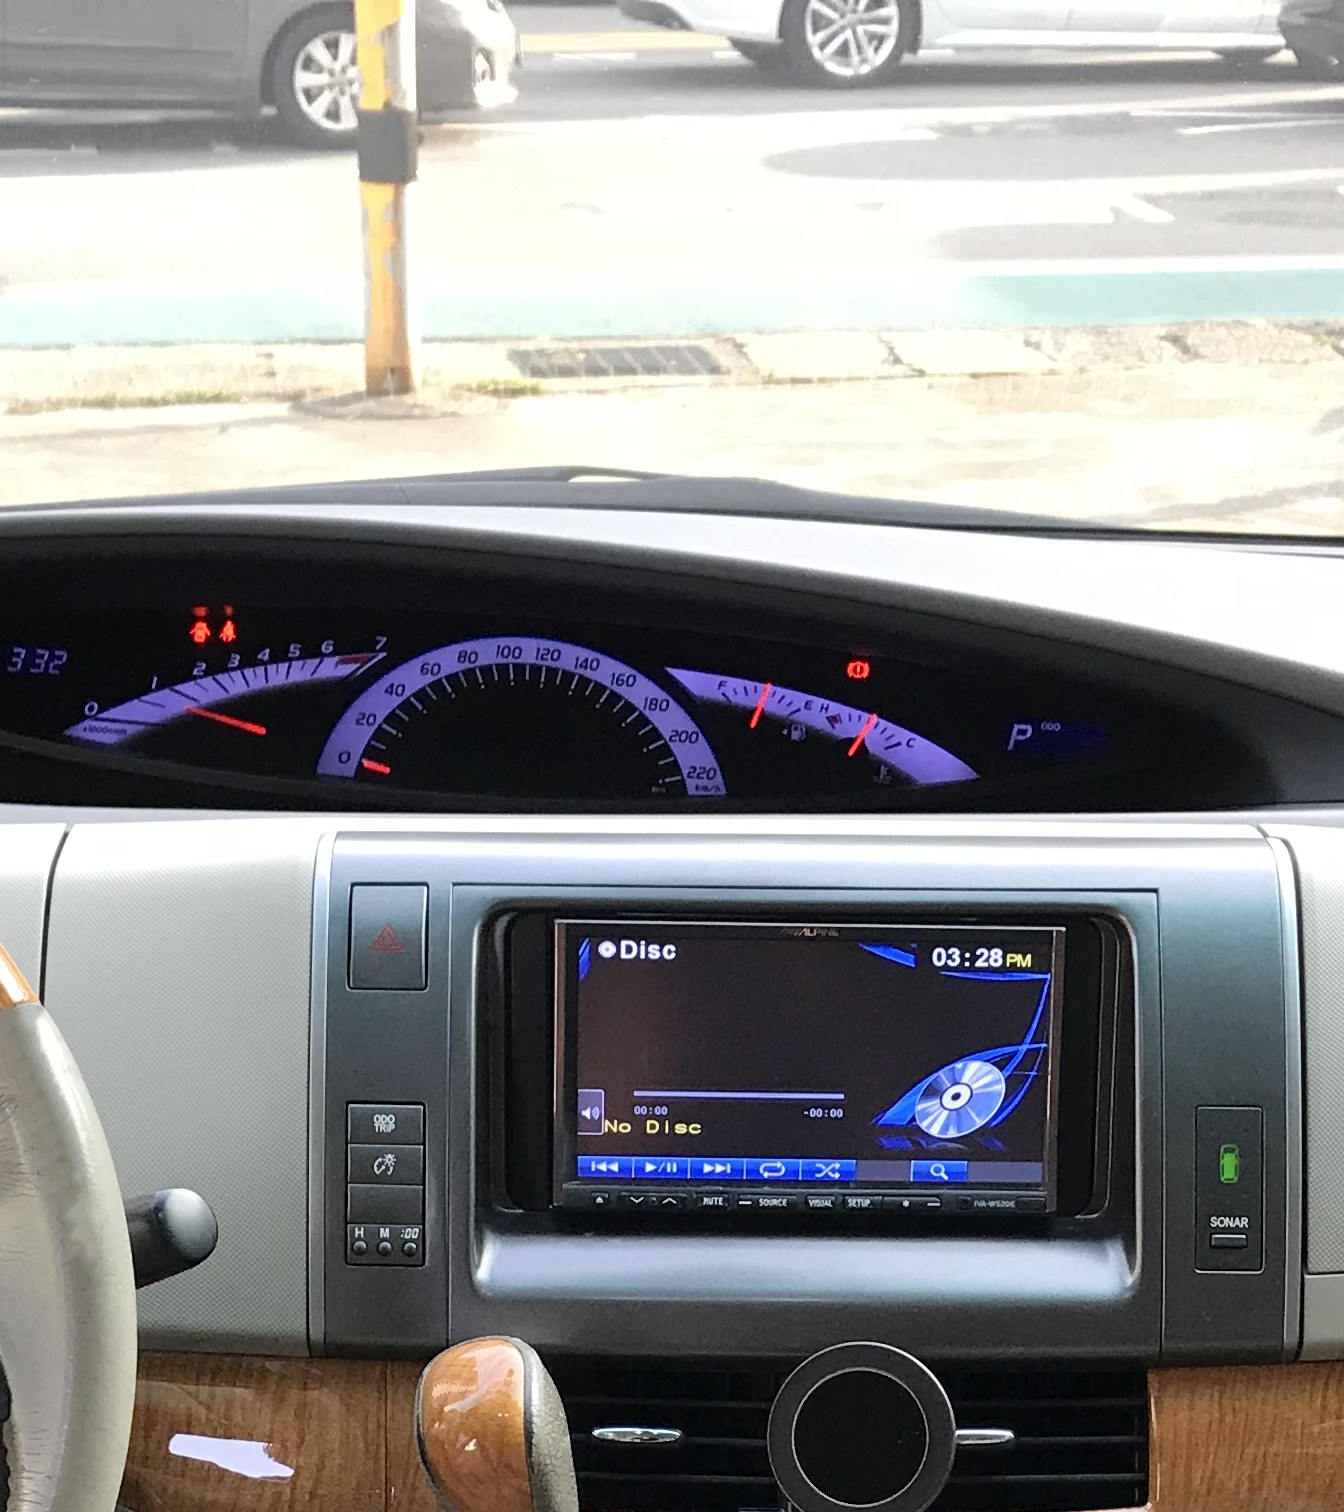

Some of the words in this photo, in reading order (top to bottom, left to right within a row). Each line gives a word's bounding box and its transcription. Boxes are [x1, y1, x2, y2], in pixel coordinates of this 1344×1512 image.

[321, 640, 334, 653] 6
[375, 636, 388, 650] 7
[257, 649, 270, 662] 4
[288, 644, 301, 657] 5
[457, 650, 479, 664] 80
[496, 645, 522, 660] 100
[535, 647, 561, 662] 120
[228, 654, 241, 667] 3
[574, 656, 600, 671] 140
[193, 662, 206, 675] 2
[420, 662, 441, 676] 60
[610, 673, 637, 688] 160
[717, 680, 728, 691] F
[384, 683, 406, 697] 40
[84, 702, 98, 716] 0
[643, 698, 670, 712] 180
[804, 700, 813, 711] E
[819, 703, 830, 714] H
[356, 712, 377, 726] 20
[668, 729, 699, 744] 200
[906, 738, 916, 748] C
[1007, 723, 1032, 750] P
[338, 751, 351, 764] 0
[686, 766, 717, 780] 220
[619, 940, 677, 961] Disc
[931, 947, 1003, 969] 03:28
[1007, 953, 1032, 969] PM
[633, 1105, 668, 1116] 00:00
[373, 1114, 395, 1124] ODO
[374, 1123, 395, 1133] TRIP
[604, 1119, 631, 1134] No
[703, 1197, 723, 1205] MUTE
[758, 1198, 788, 1207] SOURCE
[808, 1199, 834, 1208] VISUAL
[847, 1198, 871, 1208] SETUP
[1209, 1216, 1249, 1229] SONAR
[355, 1227, 364, 1238] H
[380, 1227, 389, 1238] M
